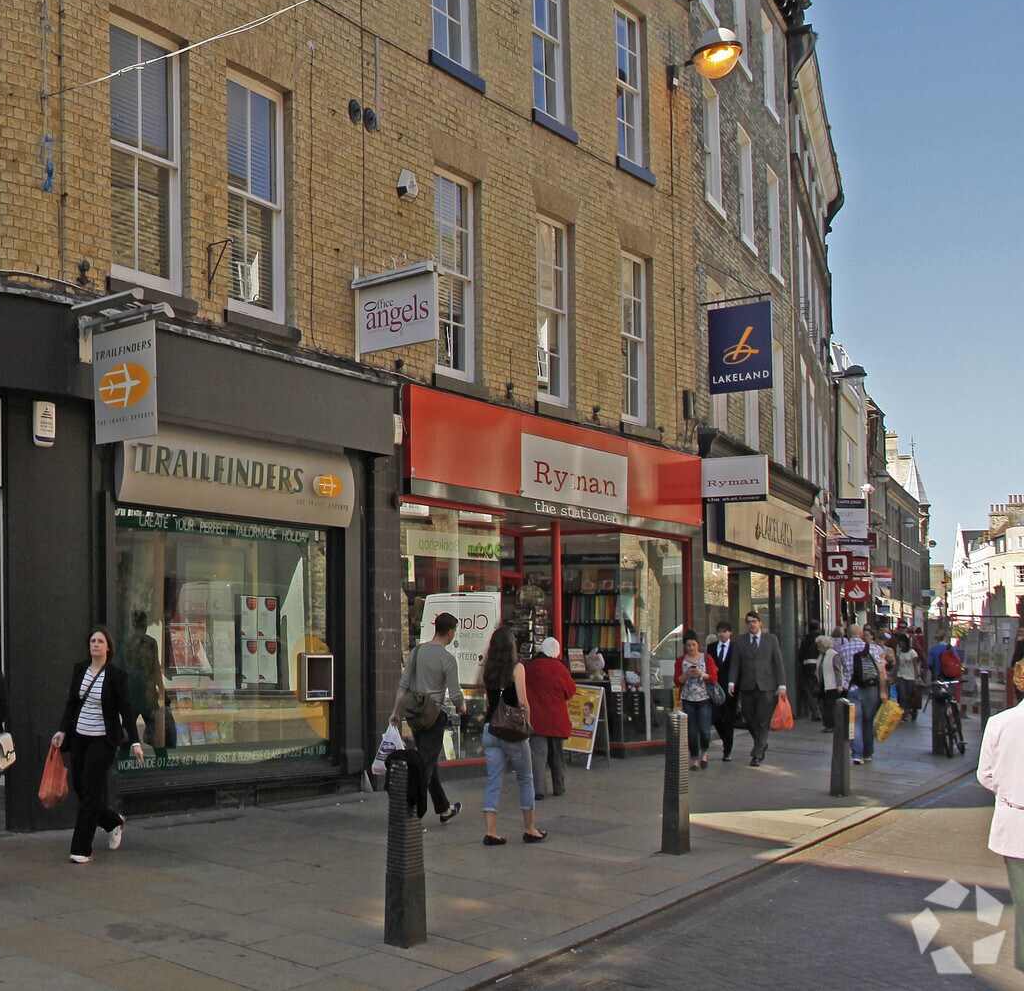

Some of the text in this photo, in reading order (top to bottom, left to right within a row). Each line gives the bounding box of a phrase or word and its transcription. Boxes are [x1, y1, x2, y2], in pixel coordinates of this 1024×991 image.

[364, 298, 394, 312] Office
[366, 293, 429, 333] angels
[95, 339, 152, 361] TRAILFINDERS
[712, 370, 770, 385] LAKELAND
[109, 417, 129, 425] TRAVEL
[130, 411, 154, 421] EXPERTS
[131, 442, 305, 495] TRAILFINDERS
[533, 460, 617, 498] Ryman
[707, 478, 760, 488] Ryman
[534, 500, 620, 525] the stationer
[139, 515, 309, 543] CREATE YOUR PERFECT TAILORMADE HOLIDAY
[761, 513, 793, 547] LAKELAND
[157, 756, 180, 768] 01223
[181, 755, 194, 766] 461
[196, 754, 209, 764] 600
[215, 752, 231, 763] FIRST
[237, 750, 263, 762] BUSINESS
[264, 748, 282, 760] CLASS
